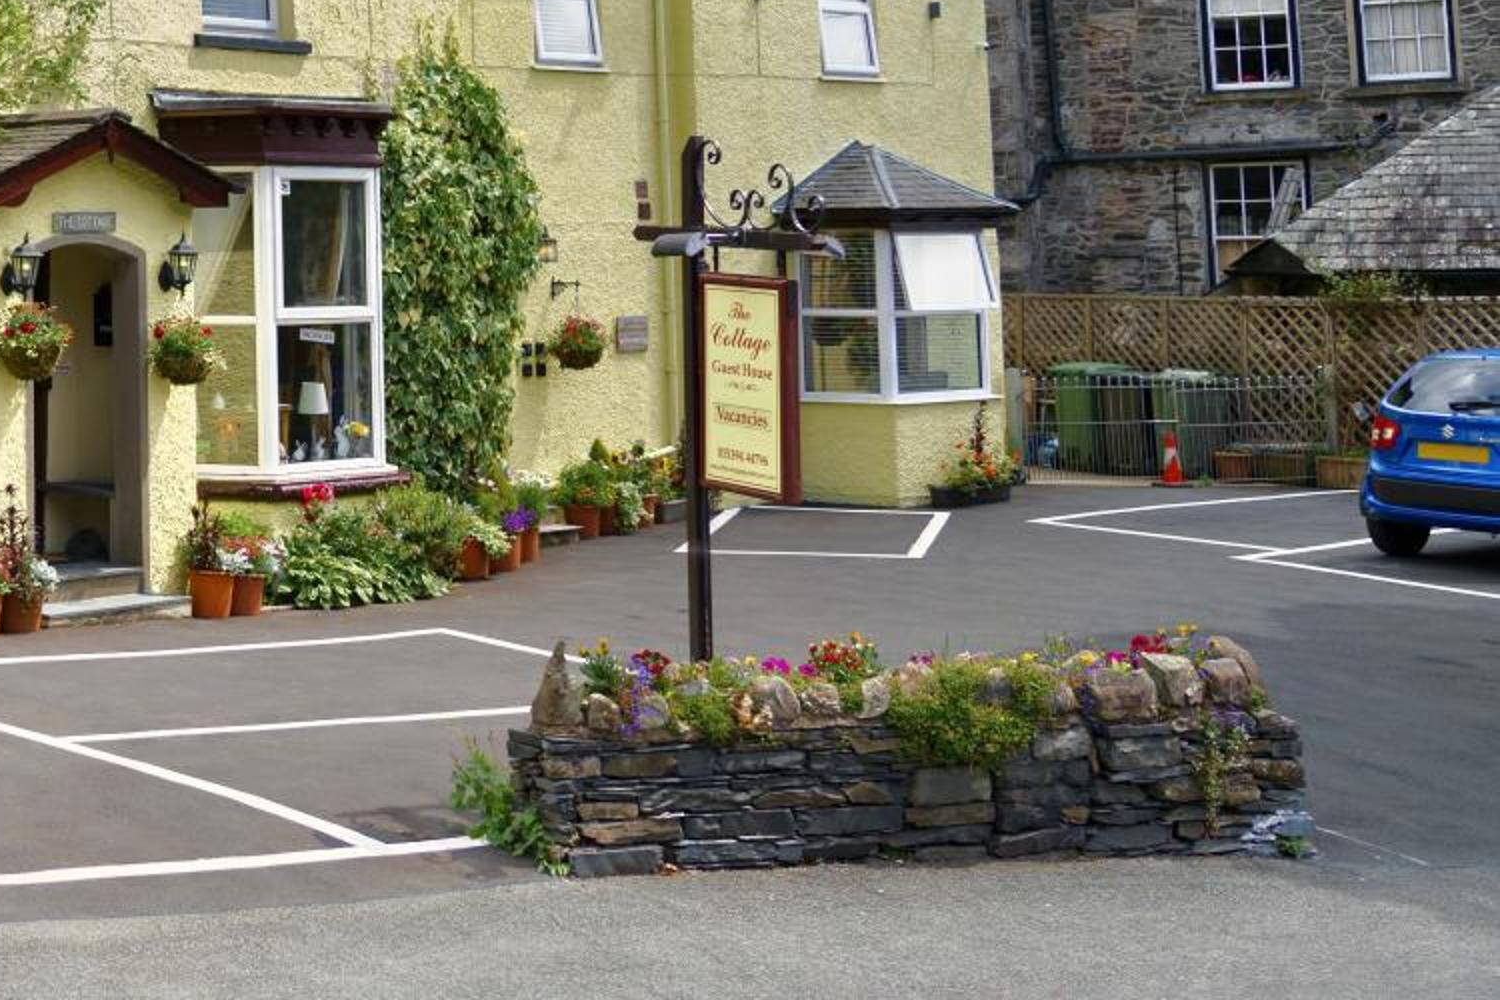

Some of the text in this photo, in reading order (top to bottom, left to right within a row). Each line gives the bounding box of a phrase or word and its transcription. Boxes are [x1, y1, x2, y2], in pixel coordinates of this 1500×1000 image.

[727, 301, 751, 320] The
[711, 322, 770, 359] Cottage
[713, 360, 773, 380] Guest House
[716, 405, 769, 429] Vacancies
